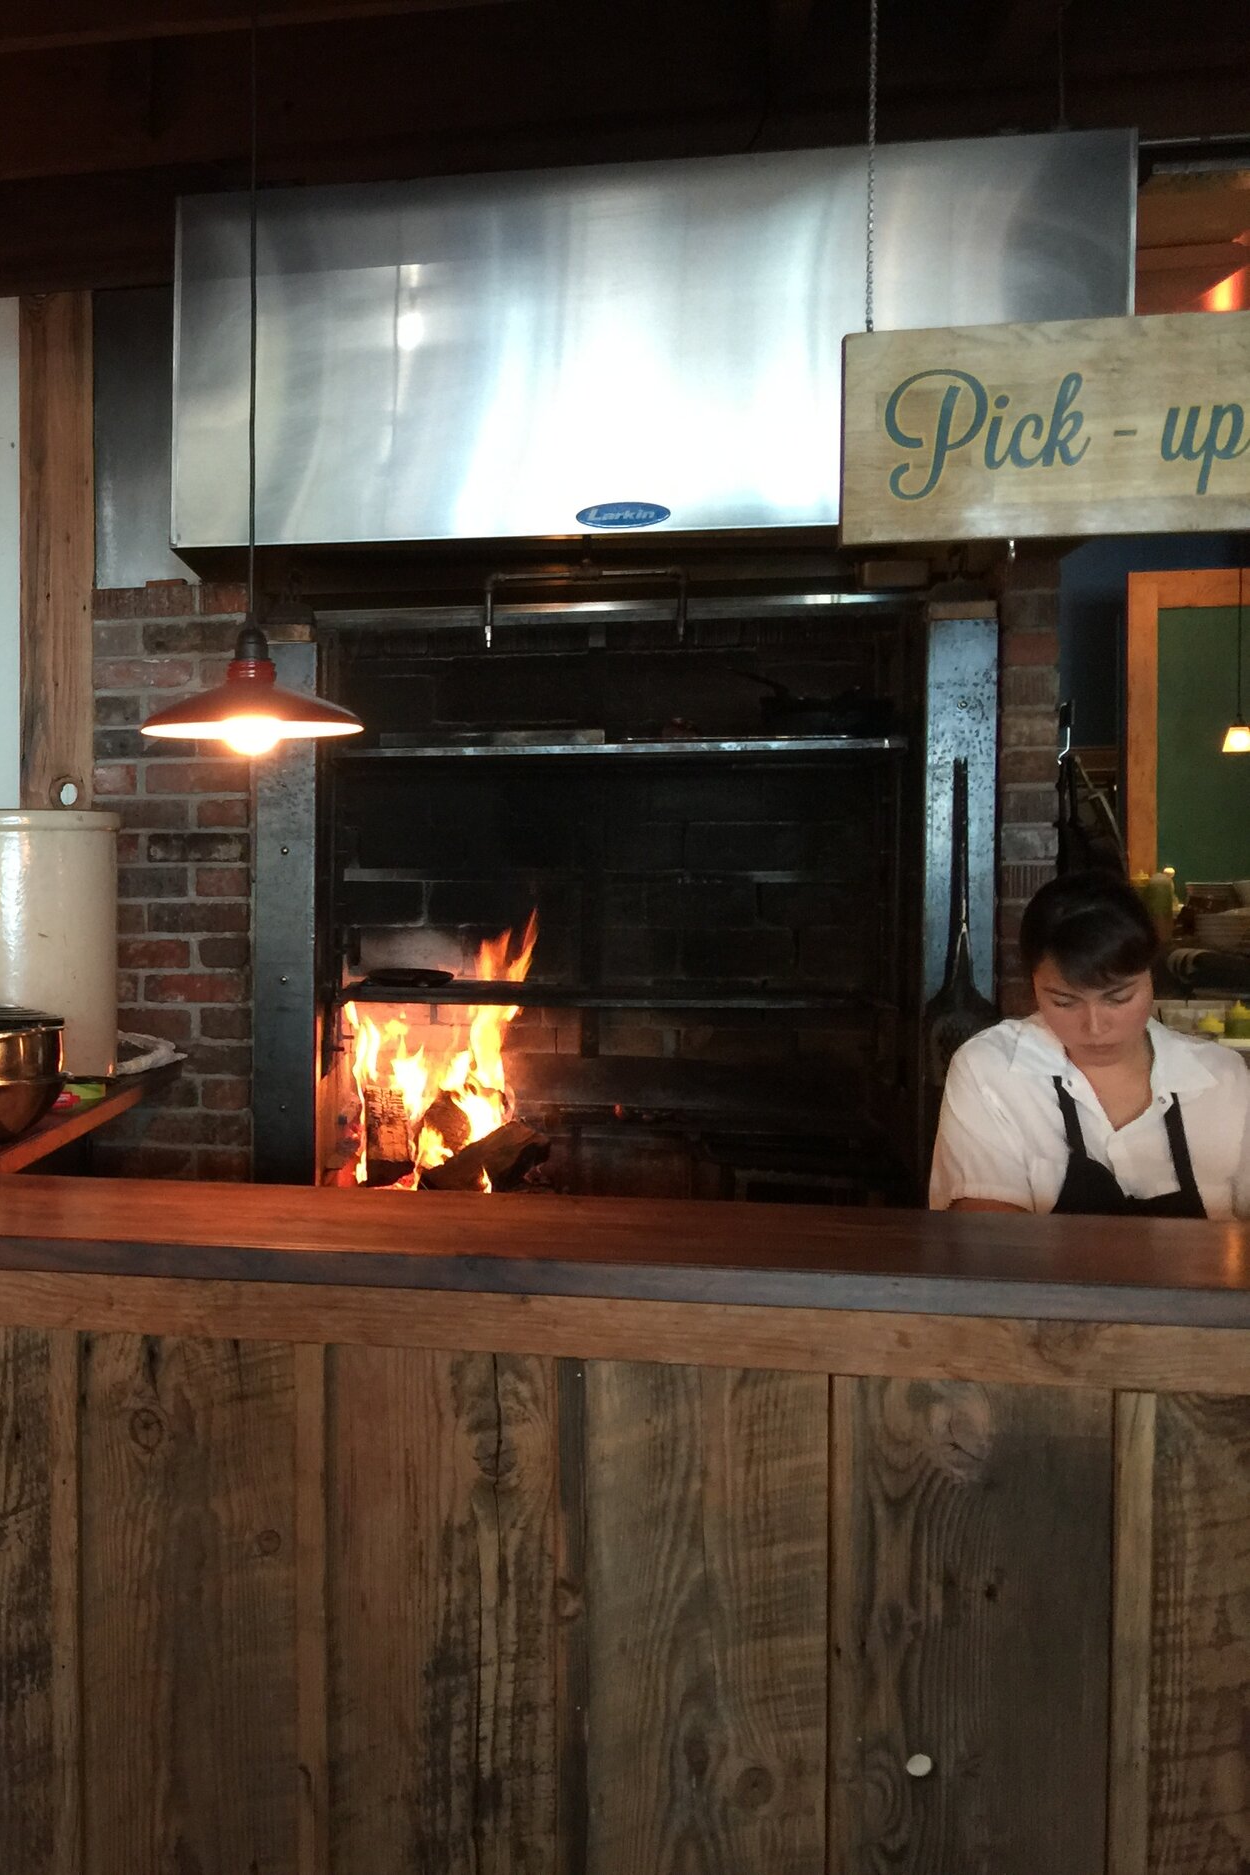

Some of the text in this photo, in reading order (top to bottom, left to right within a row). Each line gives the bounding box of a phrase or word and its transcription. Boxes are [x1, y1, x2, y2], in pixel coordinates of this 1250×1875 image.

[885, 369, 1091, 500] Pick
[1161, 403, 1250, 494] up
[587, 507, 656, 521] Larkin
